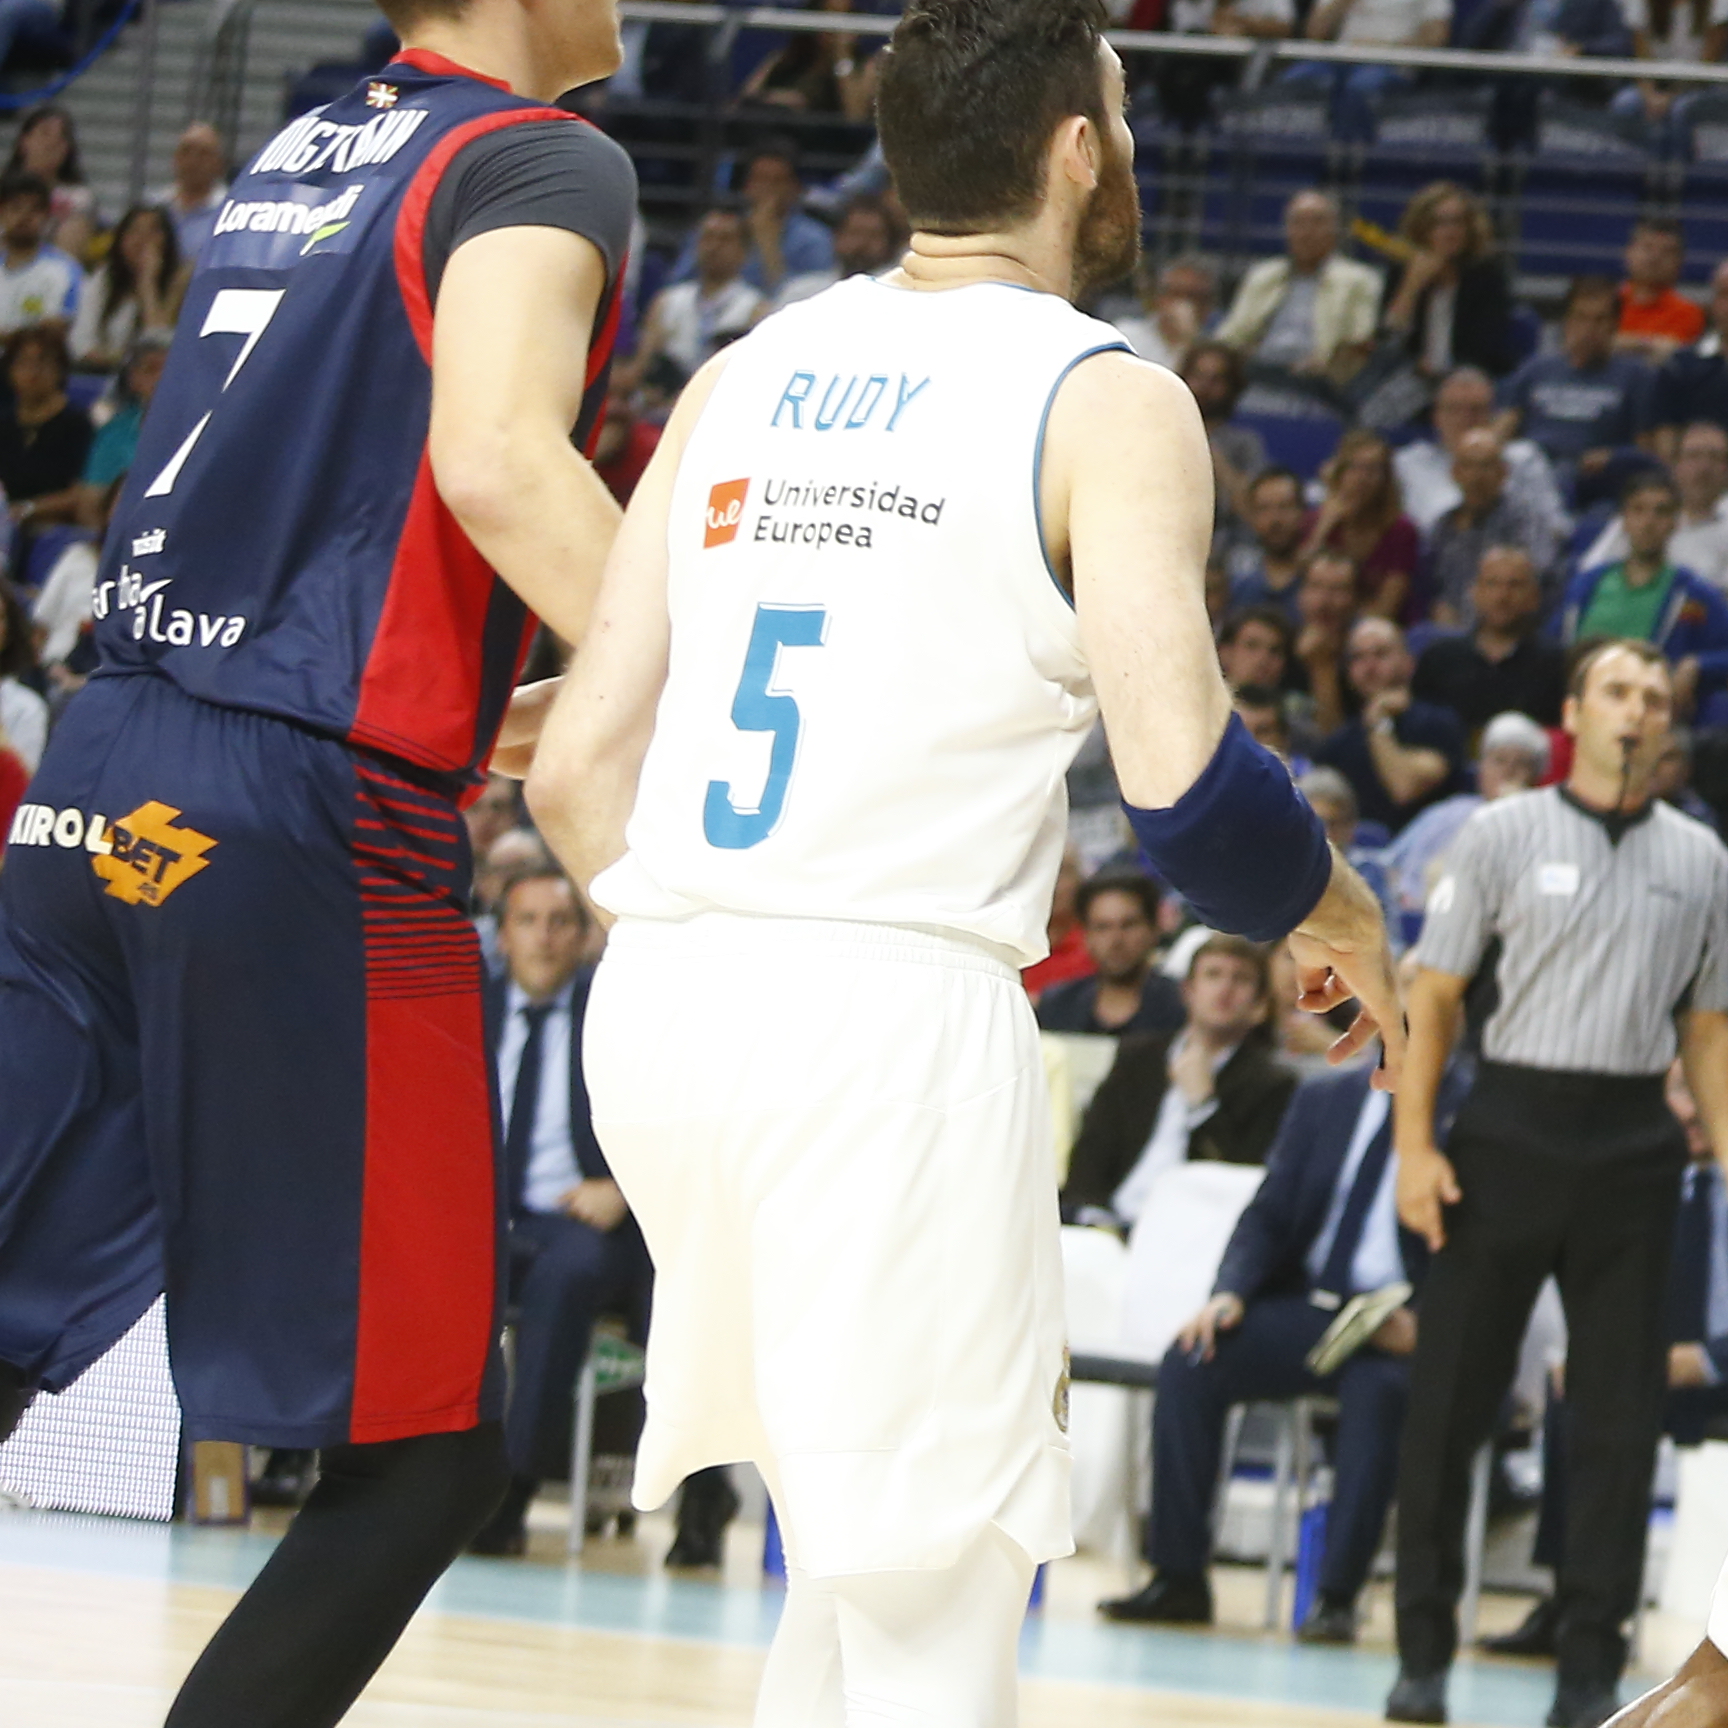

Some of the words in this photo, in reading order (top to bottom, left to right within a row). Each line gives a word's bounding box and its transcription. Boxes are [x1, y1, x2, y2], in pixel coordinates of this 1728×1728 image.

[144, 288, 287, 498] 7
[770, 369, 932, 432] RUDY
[754, 515, 873, 550] Europea
[763, 478, 945, 526] Universidad
[703, 601, 832, 849] 5
